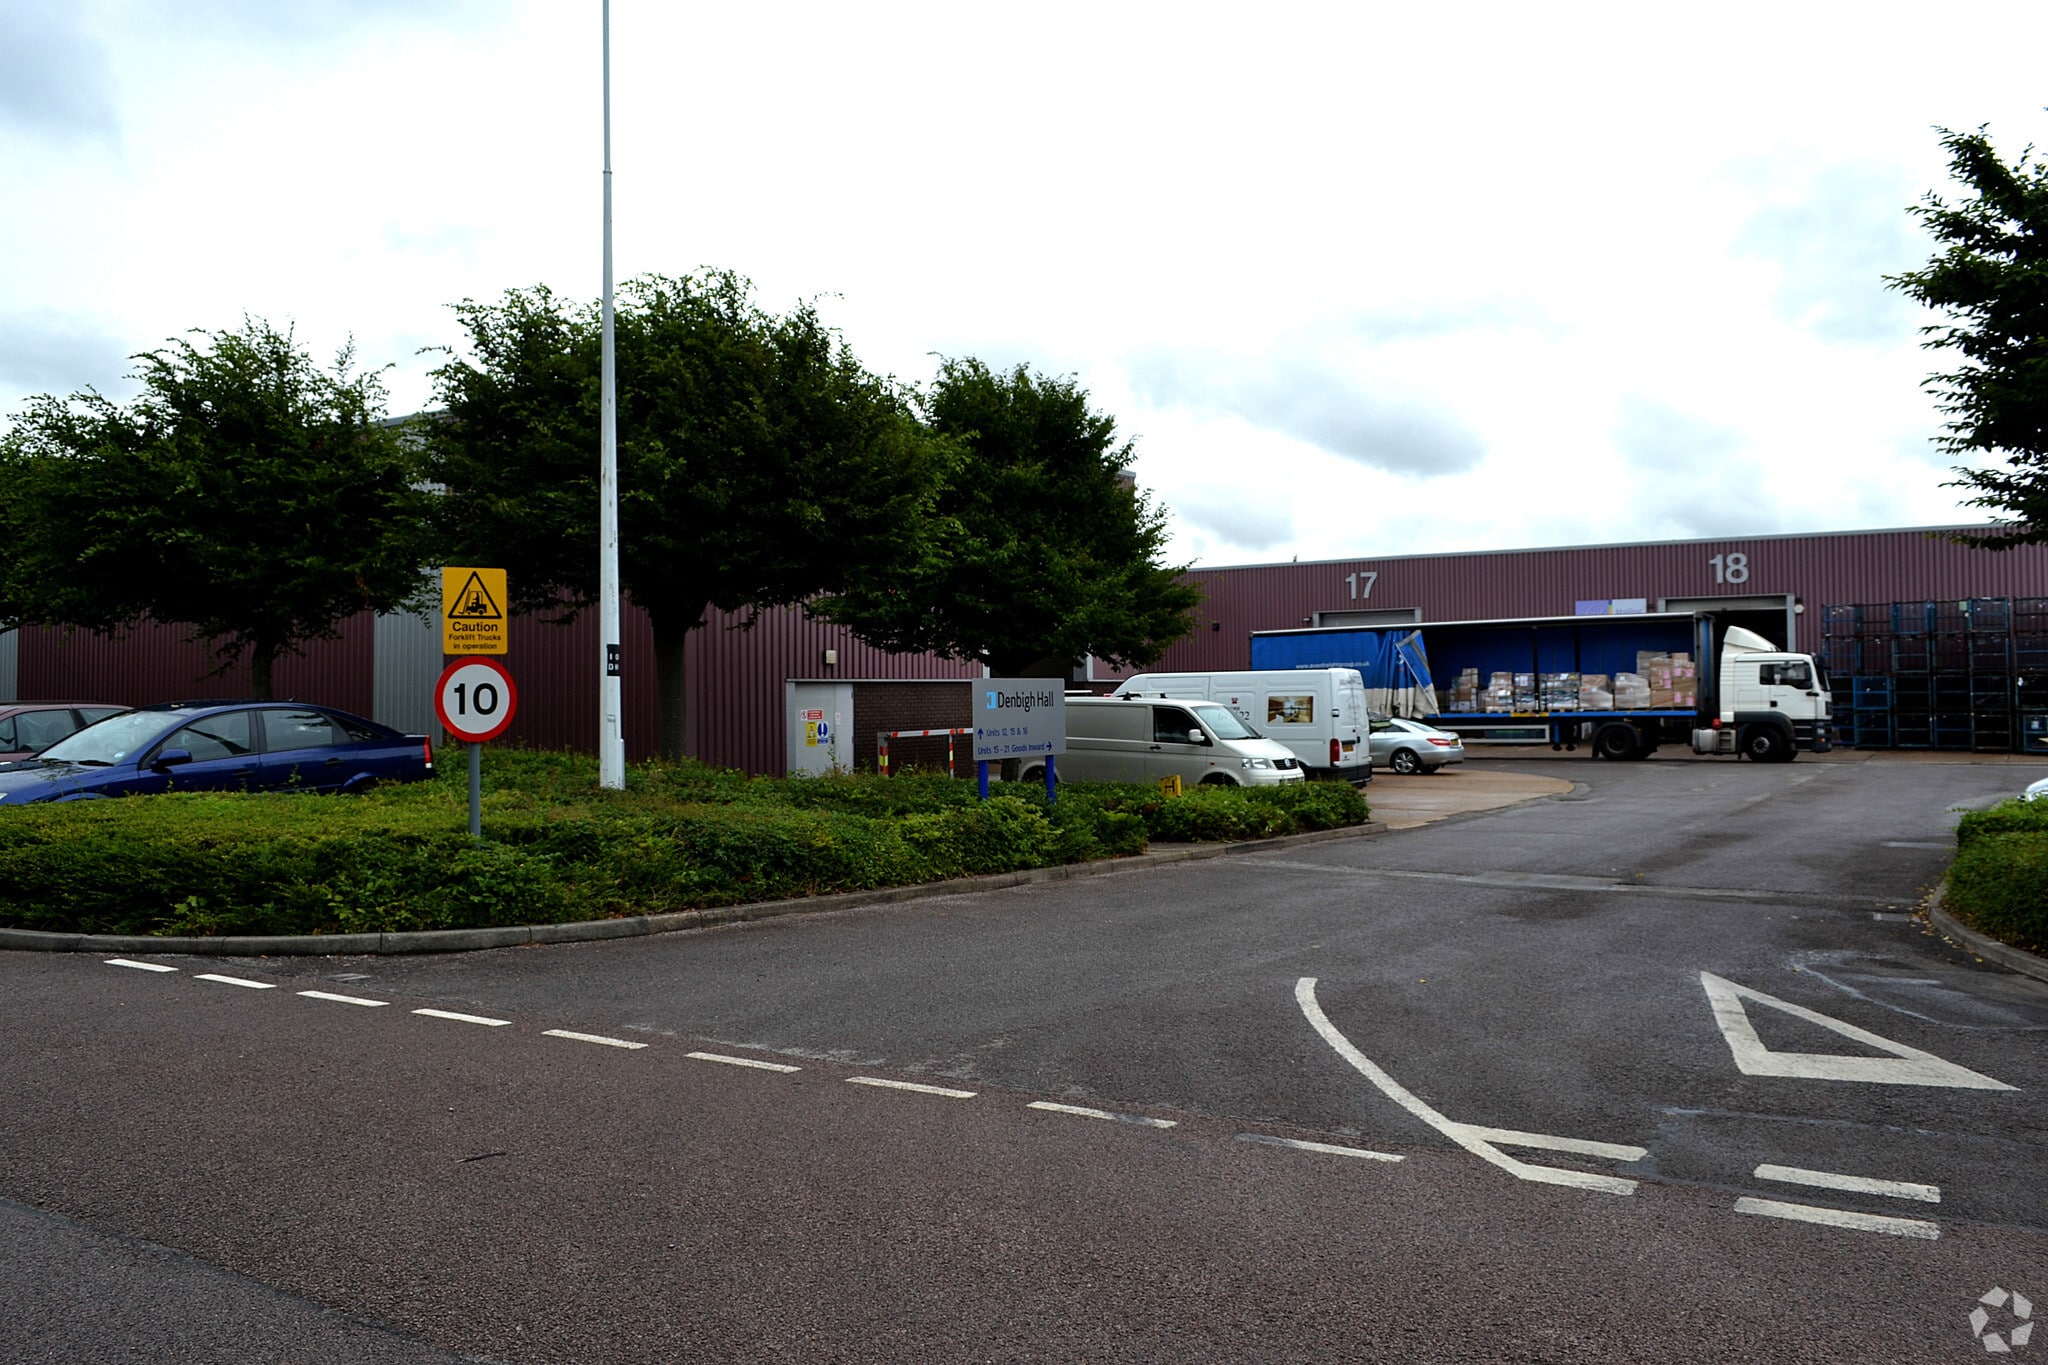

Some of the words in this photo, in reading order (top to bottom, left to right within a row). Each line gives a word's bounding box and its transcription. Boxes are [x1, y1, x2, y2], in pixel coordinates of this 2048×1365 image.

[1709, 552, 1749, 584] 18
[1345, 571, 1377, 599] 17
[452, 621, 498, 632] Caution
[448, 633, 475, 641] Forklift
[477, 633, 501, 641] Trucks
[462, 642, 498, 650] operation
[453, 683, 498, 715] 10
[998, 691, 1035, 712] Denbigh
[1037, 691, 1054, 707] Hall
[986, 728, 1000, 737] Units
[977, 746, 992, 755] Units
[1011, 744, 1028, 753] Goods
